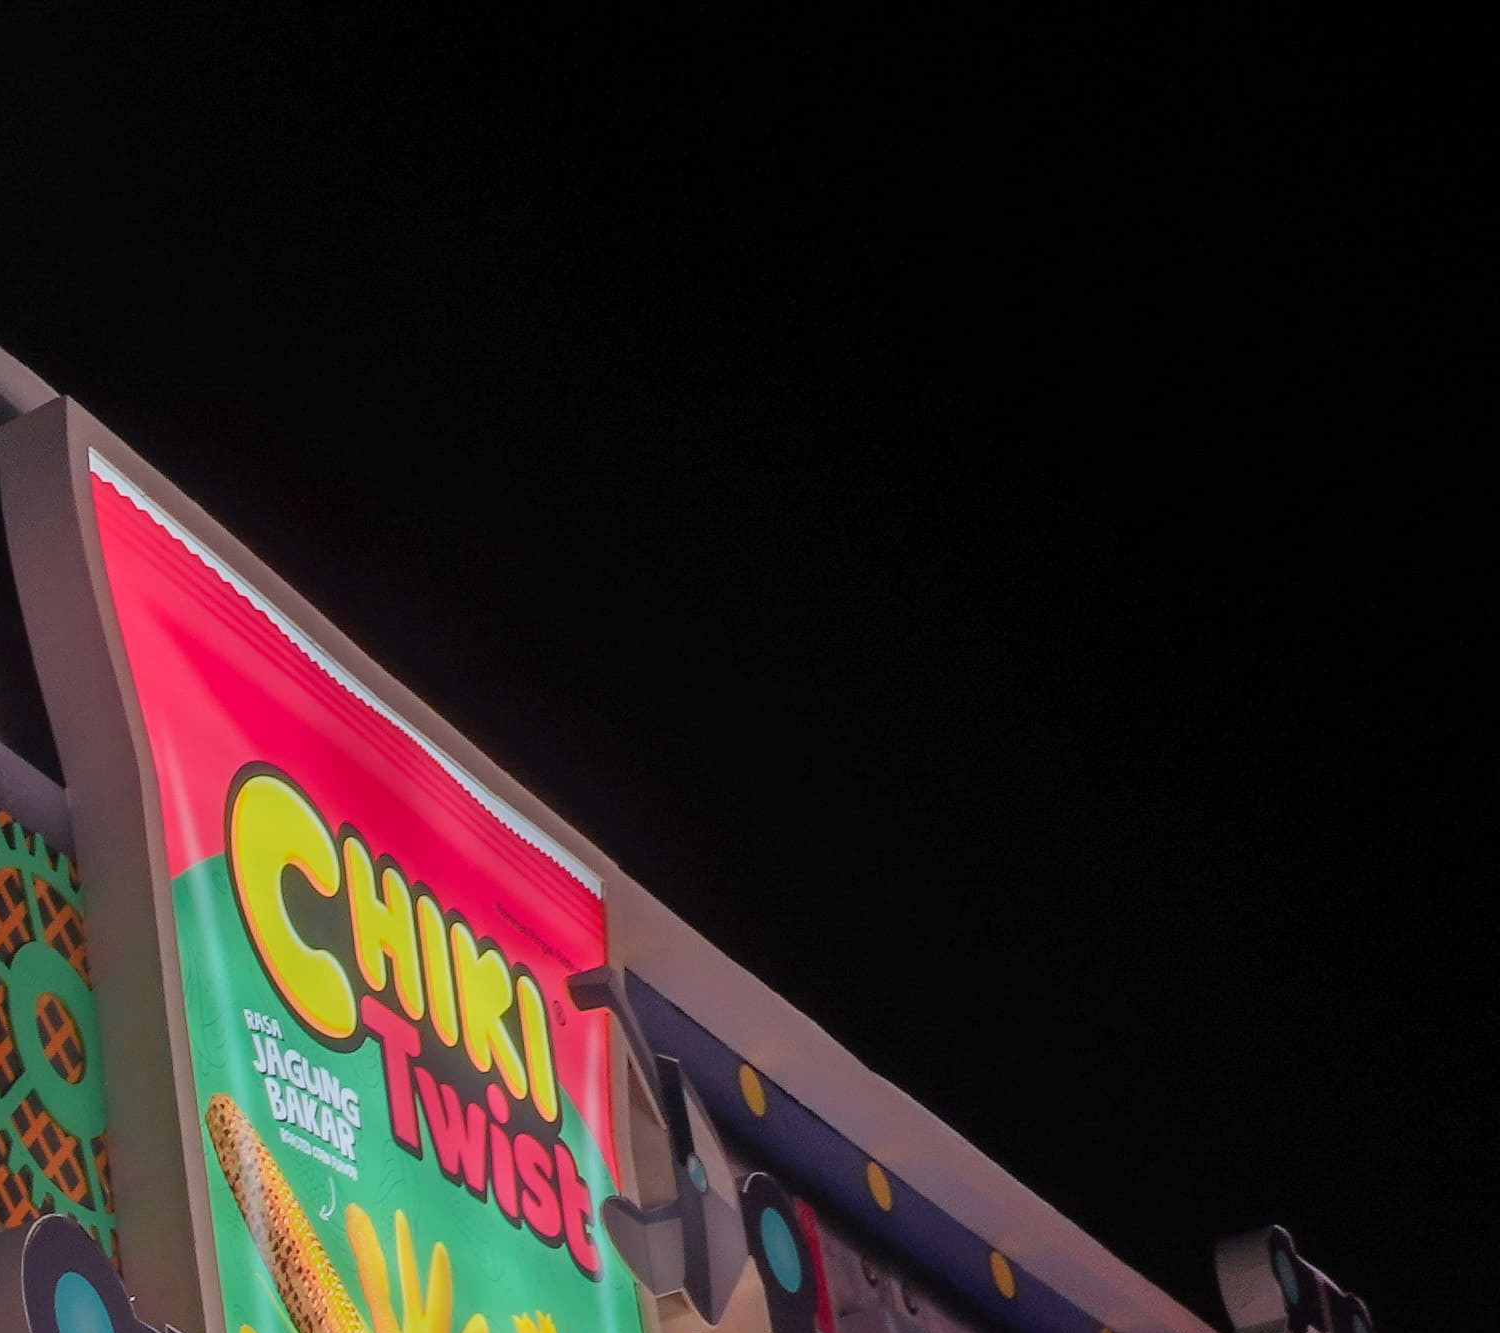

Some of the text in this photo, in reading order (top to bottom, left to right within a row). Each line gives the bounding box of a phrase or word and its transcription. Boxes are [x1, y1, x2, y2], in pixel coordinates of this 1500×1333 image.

[227, 762, 561, 1126] CHIKI
[243, 1008, 284, 1040] RASA
[252, 1033, 362, 1130] JAGUNG
[264, 1076, 357, 1162] BAKAR
